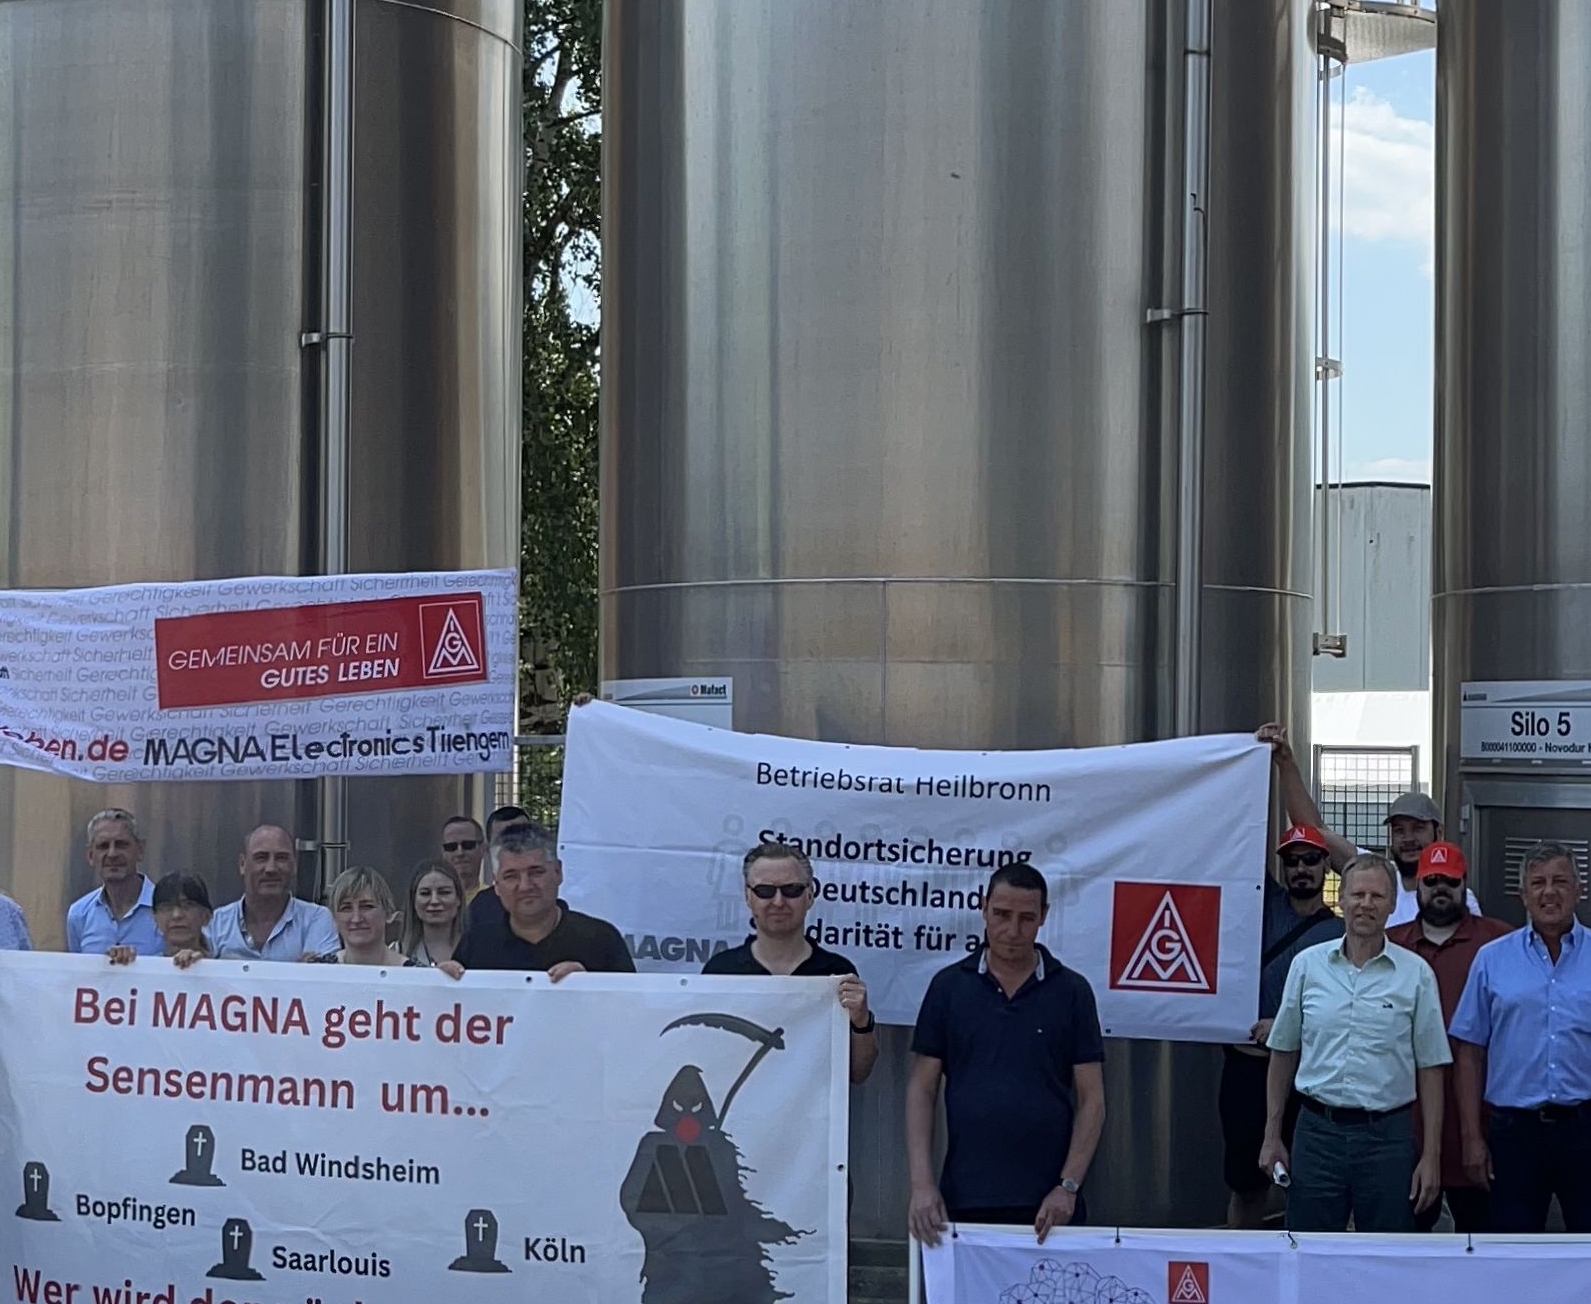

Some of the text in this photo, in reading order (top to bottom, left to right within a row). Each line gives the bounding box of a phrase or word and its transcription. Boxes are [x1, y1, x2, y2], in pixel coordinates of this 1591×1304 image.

[168, 632, 398, 671] GEMEINSAM FÜR EIN
[260, 658, 400, 689] GUTES LEBEN
[1511, 711, 1571, 736] Silo 5
[144, 734, 267, 766] MAGNA
[271, 727, 424, 761] Electronics
[1545, 742, 1585, 753] Novodur
[755, 761, 1052, 804] Betriebsrat Heilbronn
[914, 924, 957, 951] für
[73, 987, 515, 1049] Bei MAGNA geht der
[85, 1055, 491, 1118] Sensenmann um...
[240, 1148, 440, 1186] Bad Windsheim
[75, 1193, 197, 1228] Bopfingen
[271, 1243, 392, 1279] Saarlouis
[524, 1234, 587, 1265] Köln
